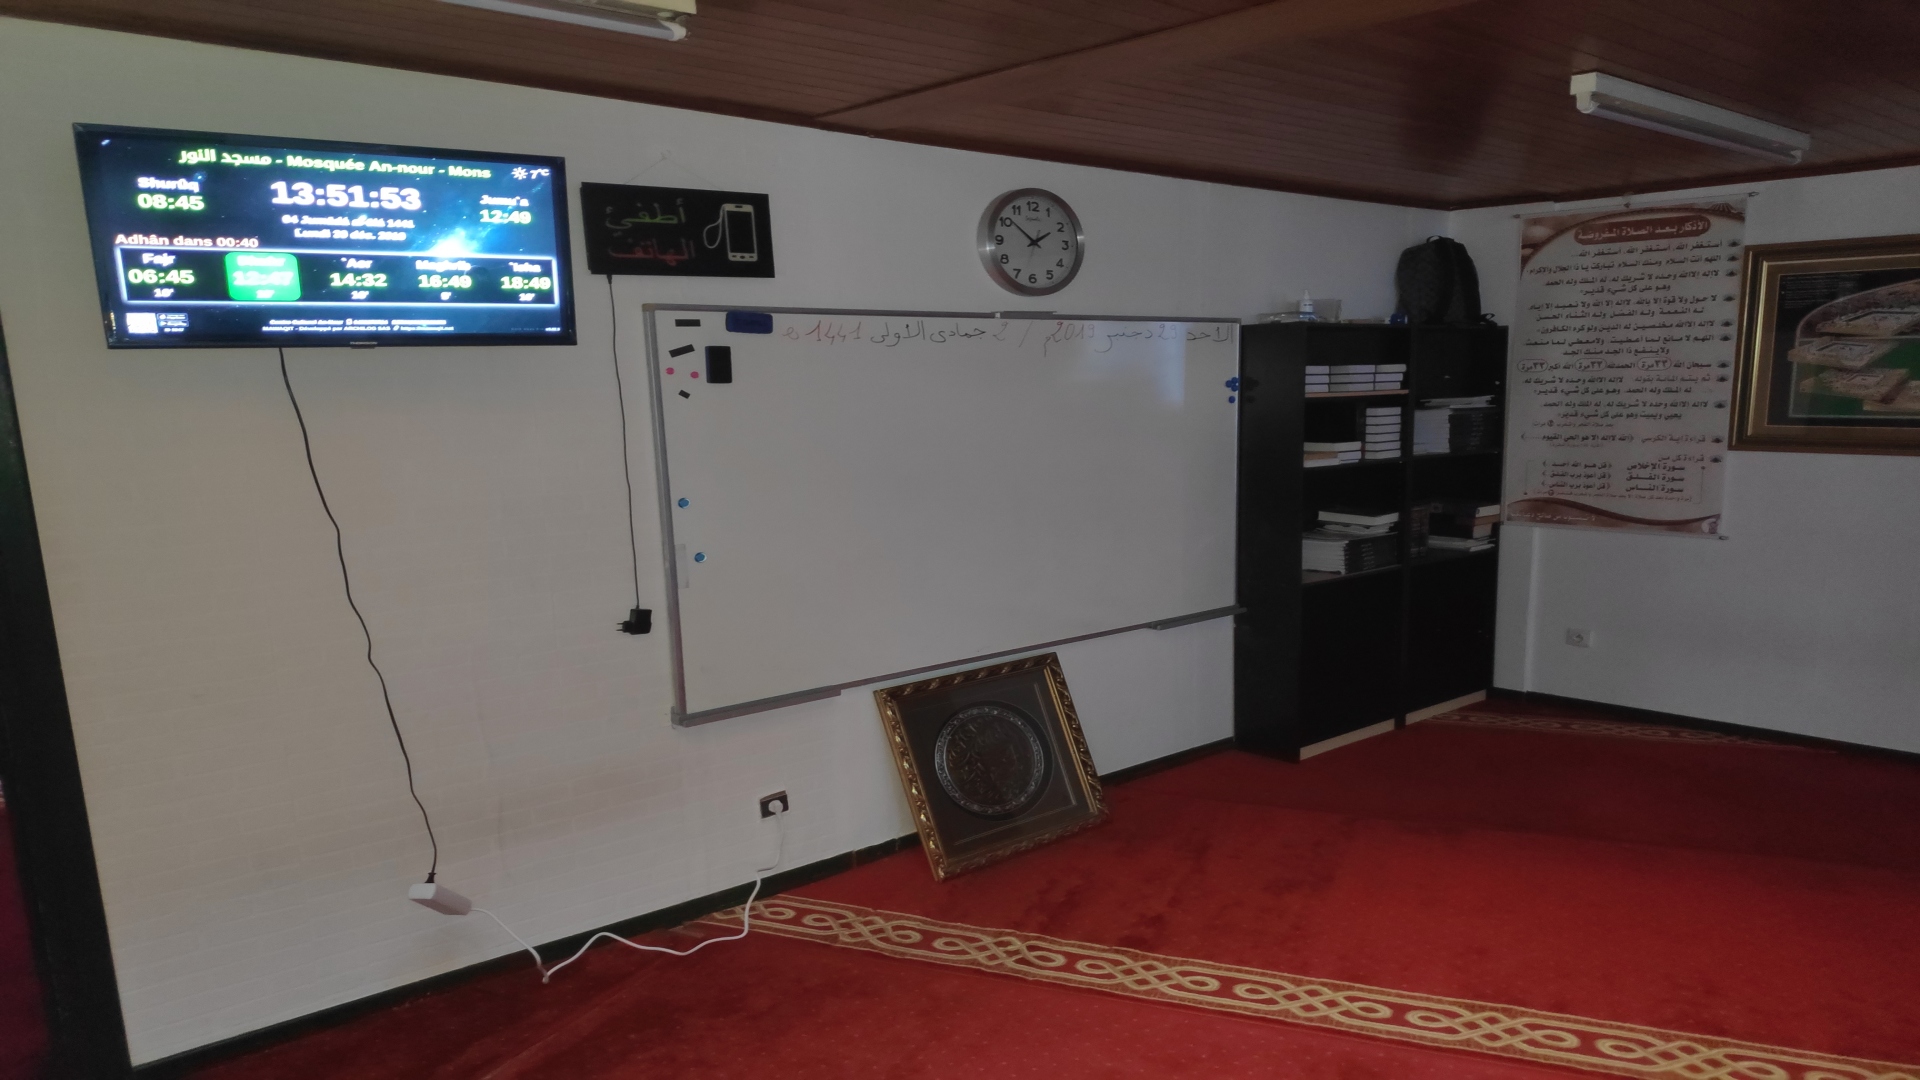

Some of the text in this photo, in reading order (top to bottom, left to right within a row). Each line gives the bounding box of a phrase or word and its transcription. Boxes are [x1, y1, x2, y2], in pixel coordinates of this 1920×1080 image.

[286, 155, 492, 179] Mosquée An-nour Mons
[137, 193, 206, 211] 08:45
[270, 180, 423, 212] 13:51:53
[1012, 204, 1021, 216] 11
[1026, 200, 1040, 213] 12
[1045, 207, 1051, 218] 1
[480, 209, 532, 224] 12:49
[999, 216, 1013, 228] 10
[1056, 221, 1065, 233] 2
[1620, 225, 1653, 237] الصلاة
[1654, 225, 1679, 235] بعد
[994, 234, 1004, 246] 9
[1577, 227, 1619, 241] المفروضة
[115, 234, 259, 250] Adhân dans 00:40
[1061, 240, 1069, 251] 3
[142, 252, 177, 267] Fajr
[999, 253, 1009, 265] 8
[1055, 257, 1064, 268] 4
[127, 269, 195, 285] 06:45
[329, 272, 389, 287] 14:32
[1012, 268, 1022, 280] 7
[1028, 273, 1037, 284] 6
[1045, 269, 1054, 280] 5
[417, 274, 473, 289] 16:49
[500, 276, 552, 291] 18:49
[805, 319, 862, 346] 1441
